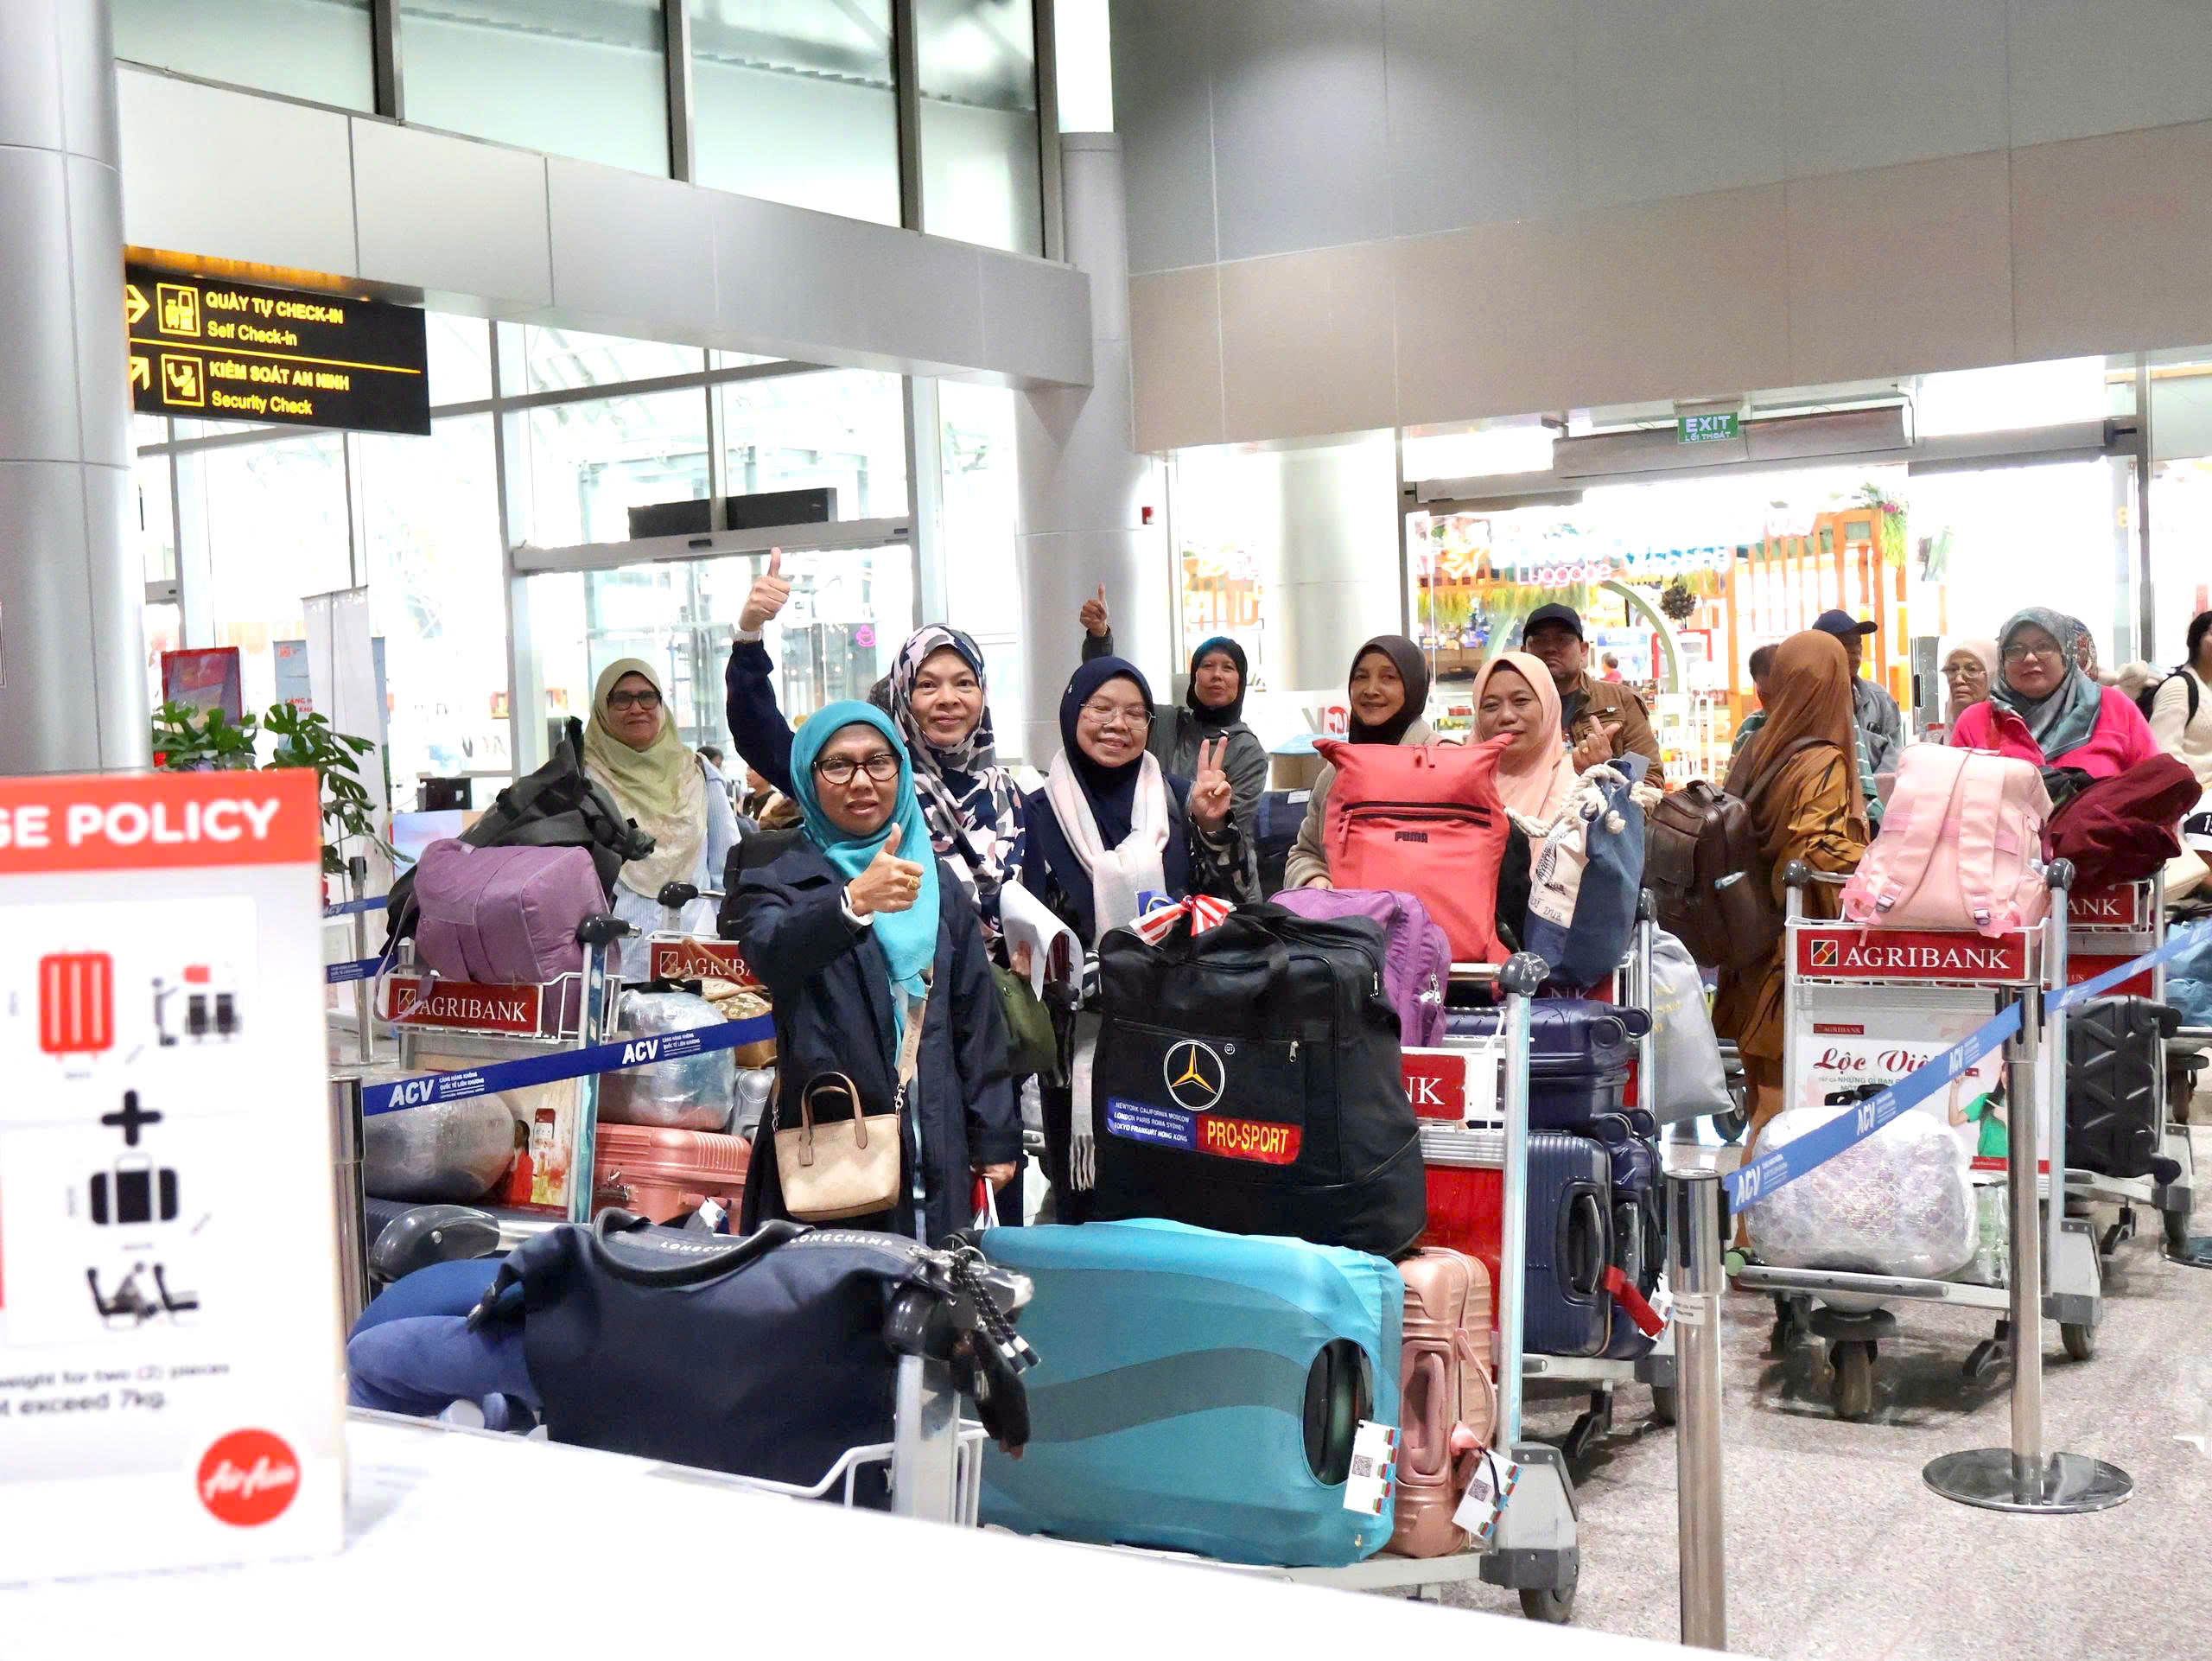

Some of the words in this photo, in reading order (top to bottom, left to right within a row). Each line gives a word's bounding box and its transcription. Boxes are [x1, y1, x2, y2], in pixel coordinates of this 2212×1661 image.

[276, 301, 344, 324] CHECK-IN
[207, 321, 235, 339] Self
[238, 324, 298, 347] Check-in
[250, 364, 290, 385] SOÁT
[292, 370, 314, 387] AN
[315, 372, 350, 391] NINH
[212, 390, 267, 414] Security
[270, 395, 313, 416] Check
[1686, 415, 1731, 433] EXIT
[67, 796, 281, 848] POLICY
[1395, 830, 1428, 843] PUMA
[683, 958, 751, 977] AGRIB
[1843, 946, 2012, 970] AGRIBANK
[420, 996, 527, 1022] AGRIBANK
[622, 1039, 658, 1065] ACV
[1813, 1047, 1867, 1074] Lộc
[1948, 1045, 1964, 1077] ACV
[388, 1079, 435, 1108] ACV
[1114, 1111, 1135, 1122] LONDON
[1857, 1101, 1875, 1136] ACV
[1158, 1130, 1173, 1139] HONG
[1173, 1133, 1188, 1142] KONG
[1207, 1120, 1289, 1155] PRO-SPORT
[1735, 1165, 1761, 1207] ACV
[19, 1391, 110, 1415] exceed
